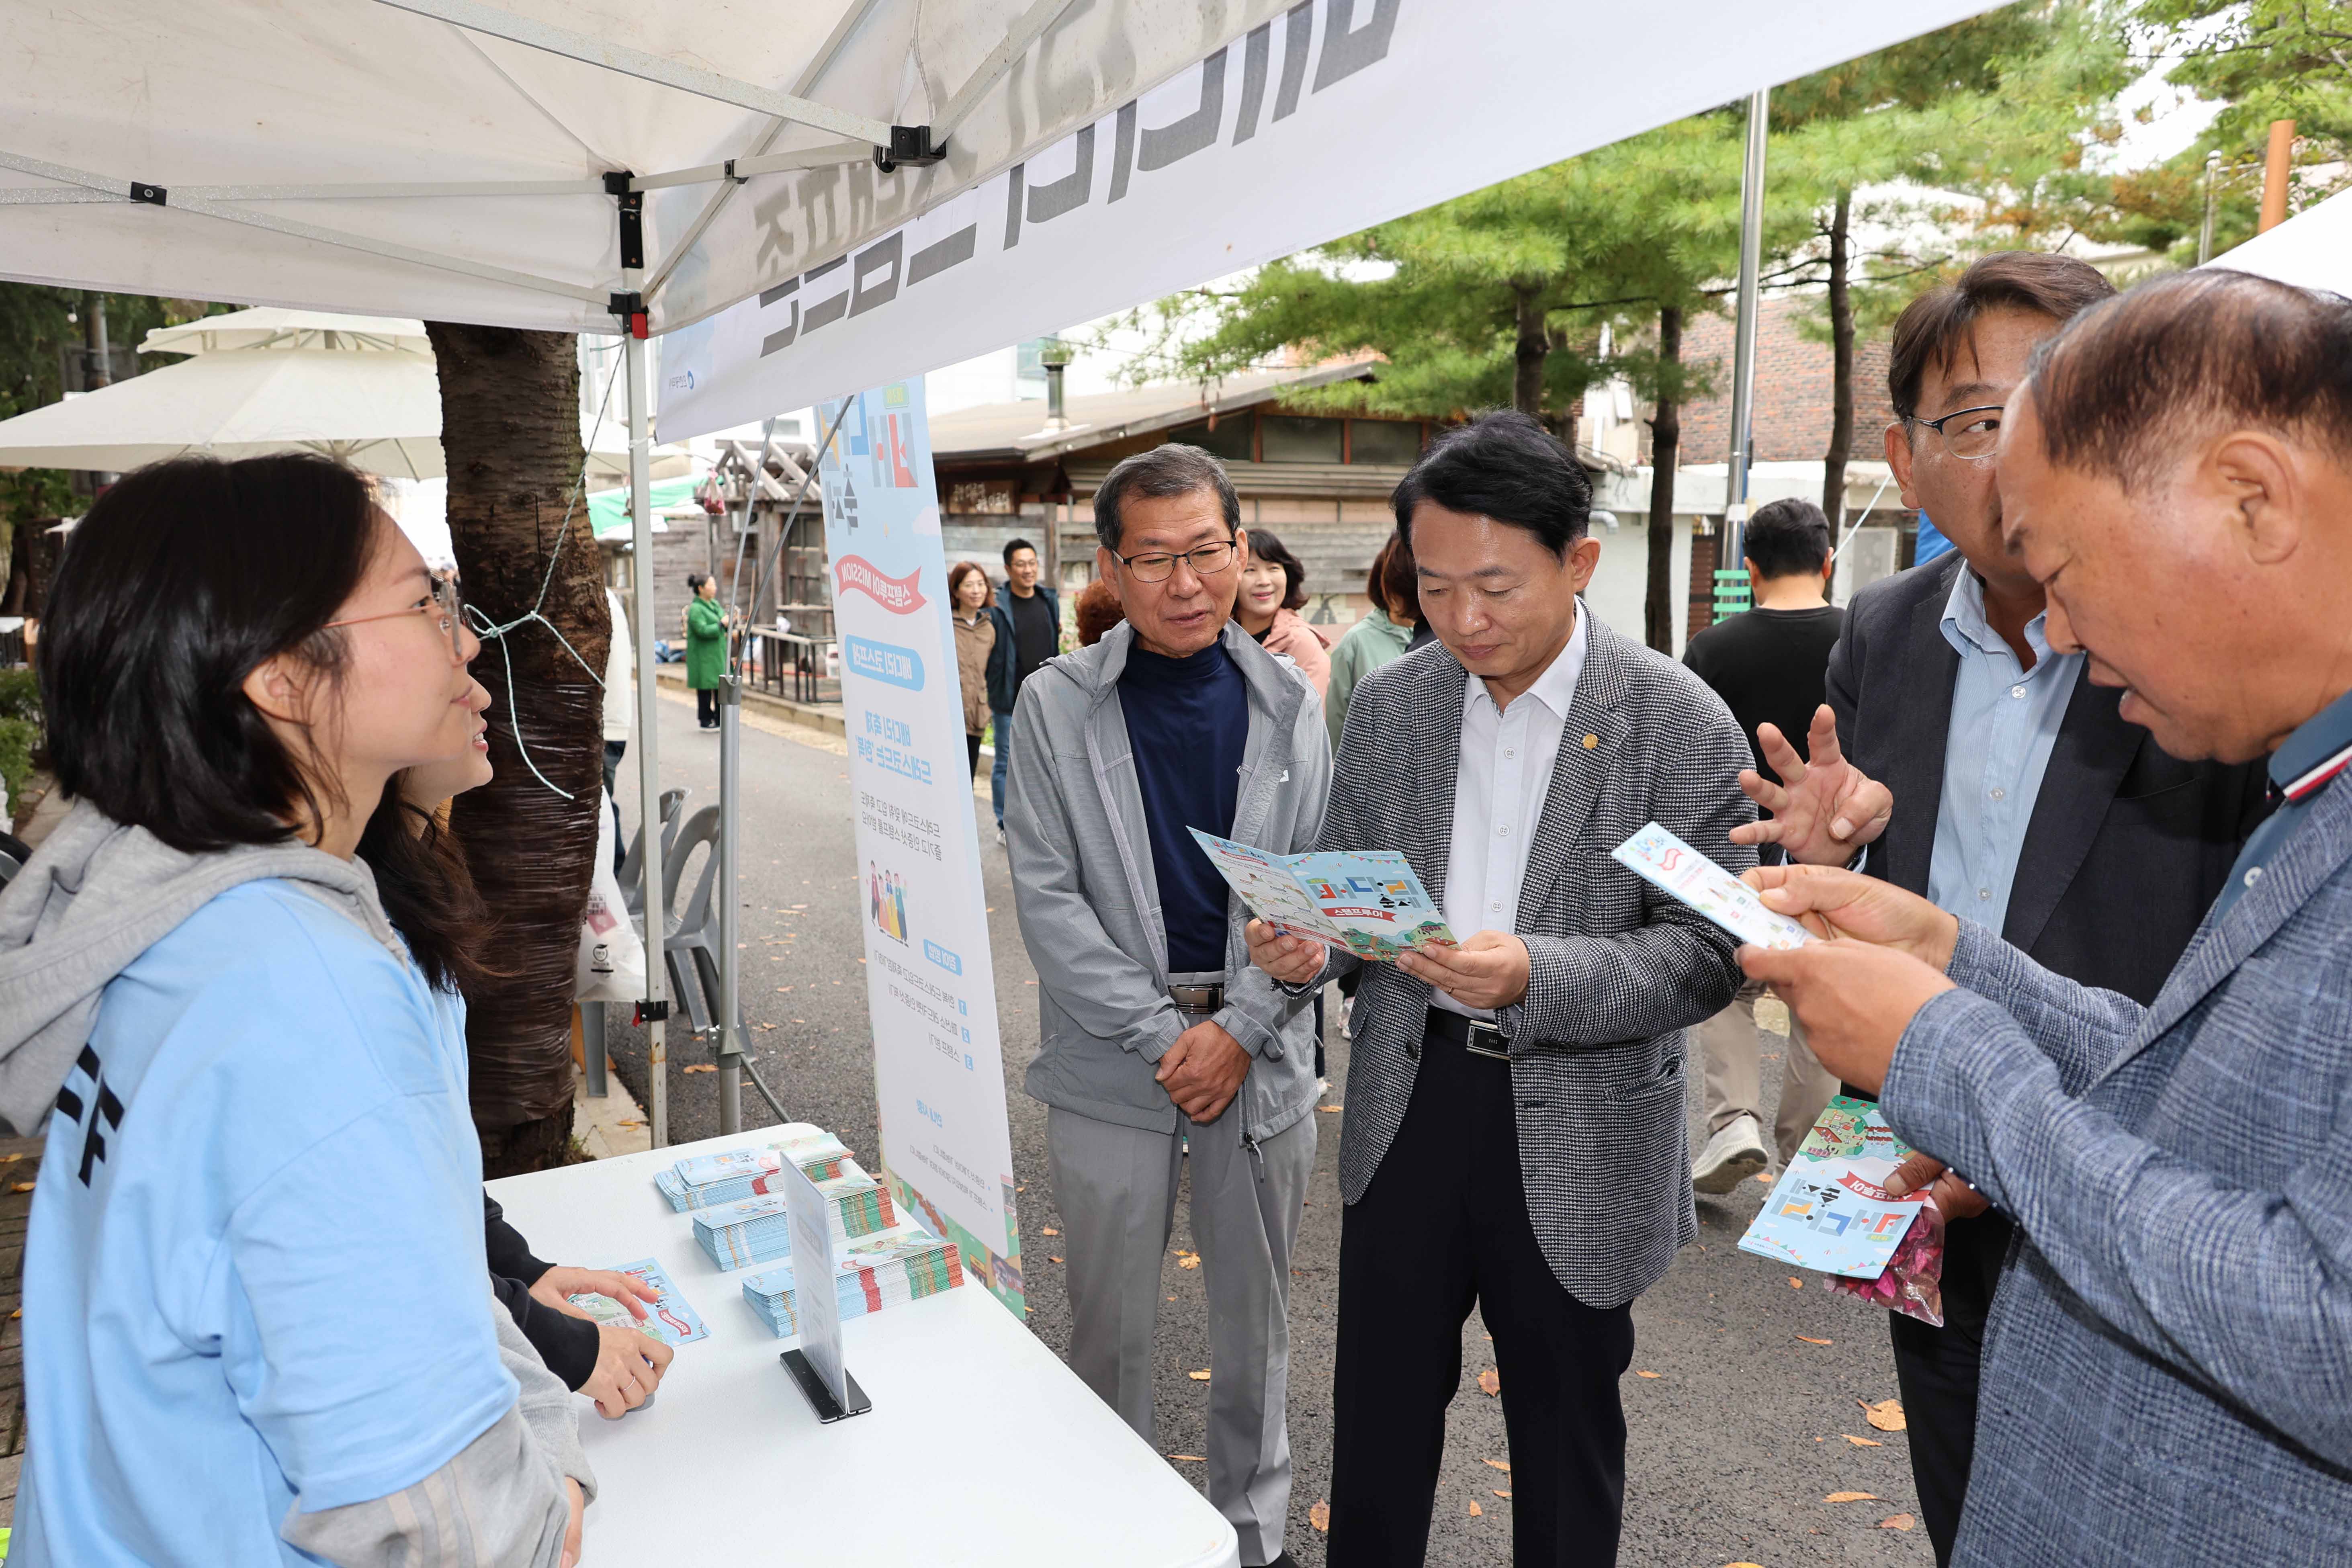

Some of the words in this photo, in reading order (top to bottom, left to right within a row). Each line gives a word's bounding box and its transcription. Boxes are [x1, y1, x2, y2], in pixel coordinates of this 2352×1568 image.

[1309, 876, 1419, 899] 배다리
[1377, 893, 1422, 910] 축제
[1335, 909, 1383, 918] 스탬프투어
[1789, 1178, 1841, 1208] 축제
[1769, 1193, 1907, 1237] 배다리
